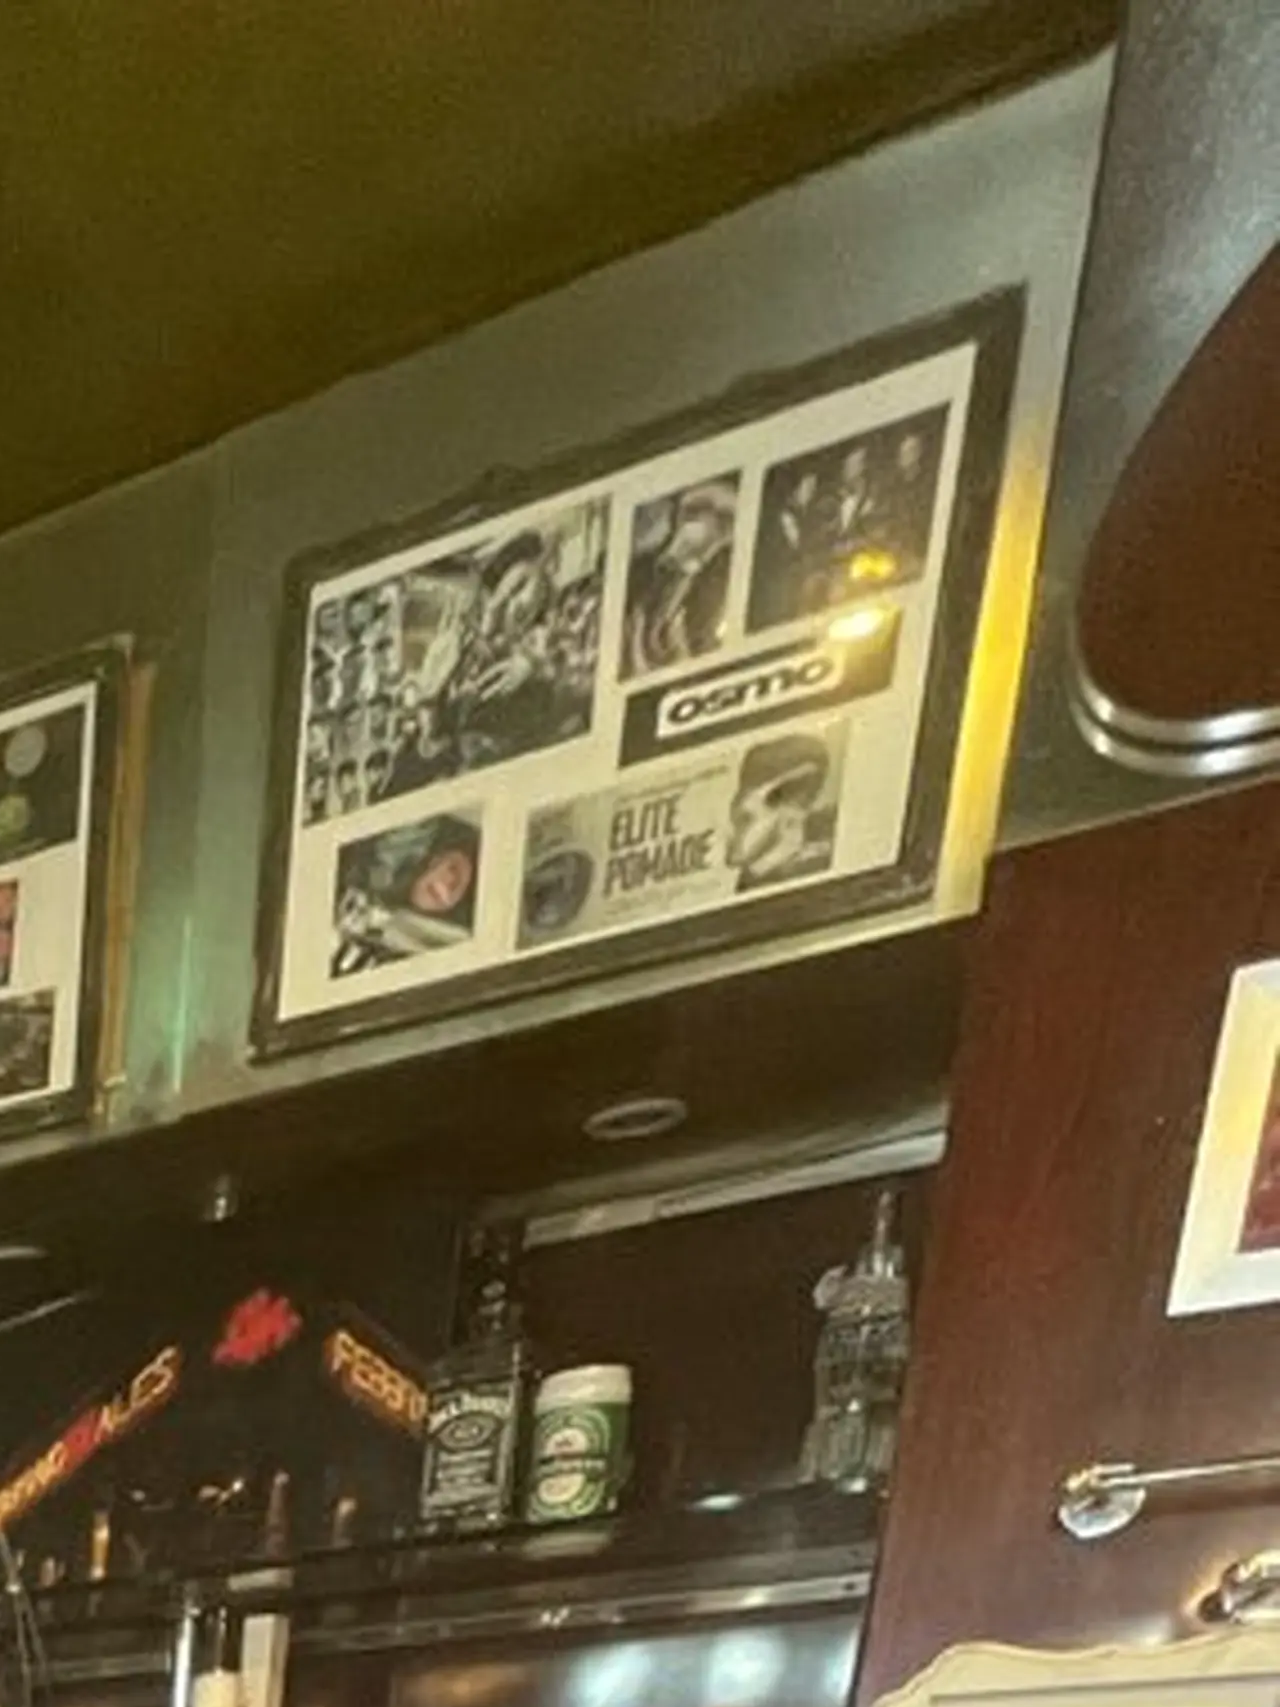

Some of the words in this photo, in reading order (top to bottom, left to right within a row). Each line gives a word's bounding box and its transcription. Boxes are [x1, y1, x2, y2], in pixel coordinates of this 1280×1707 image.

[667, 657, 833, 725] osmo
[609, 794, 682, 853] ELITE
[603, 828, 716, 898] POMADE
